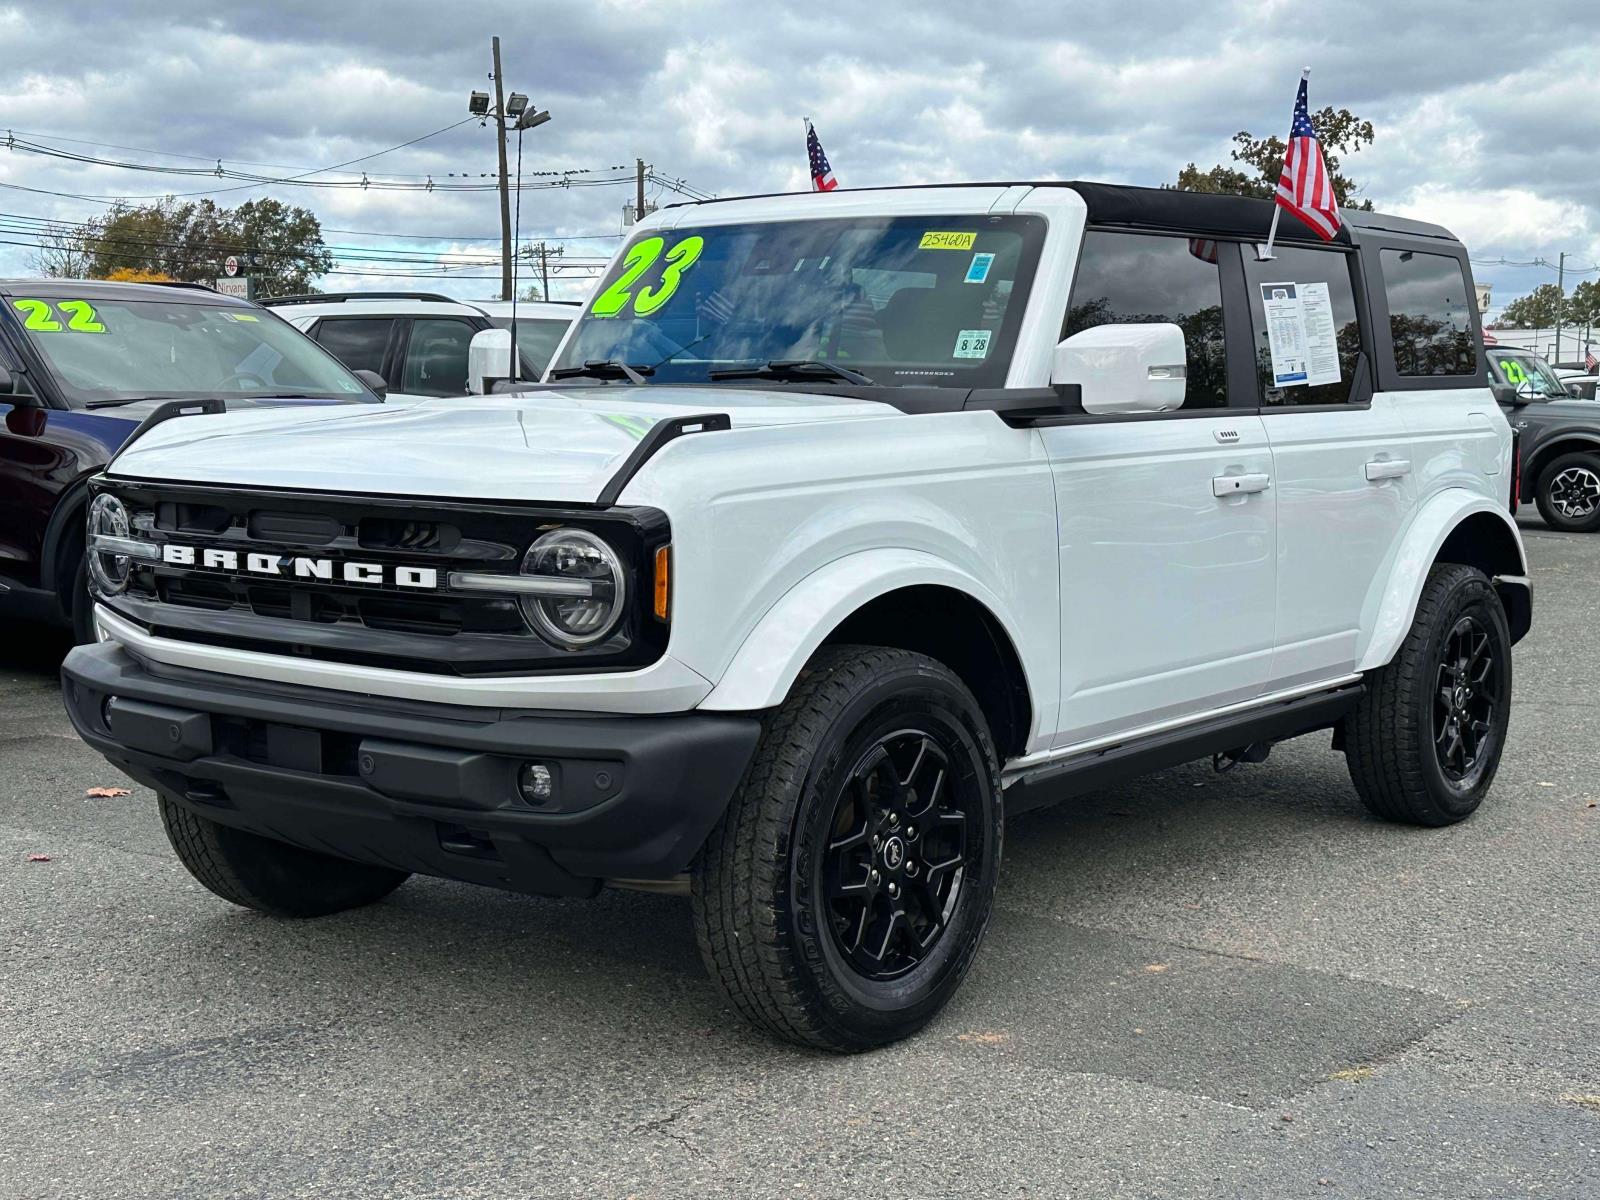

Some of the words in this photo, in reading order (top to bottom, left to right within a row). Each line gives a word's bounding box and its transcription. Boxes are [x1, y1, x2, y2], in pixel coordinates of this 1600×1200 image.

[217, 282, 247, 294] Nirvana
[591, 236, 704, 318] 23
[13, 299, 106, 333] 22
[961, 339, 969, 351] 8
[973, 339, 986, 351] 28
[1500, 360, 1529, 384] 22
[163, 544, 437, 588] BRONCO
